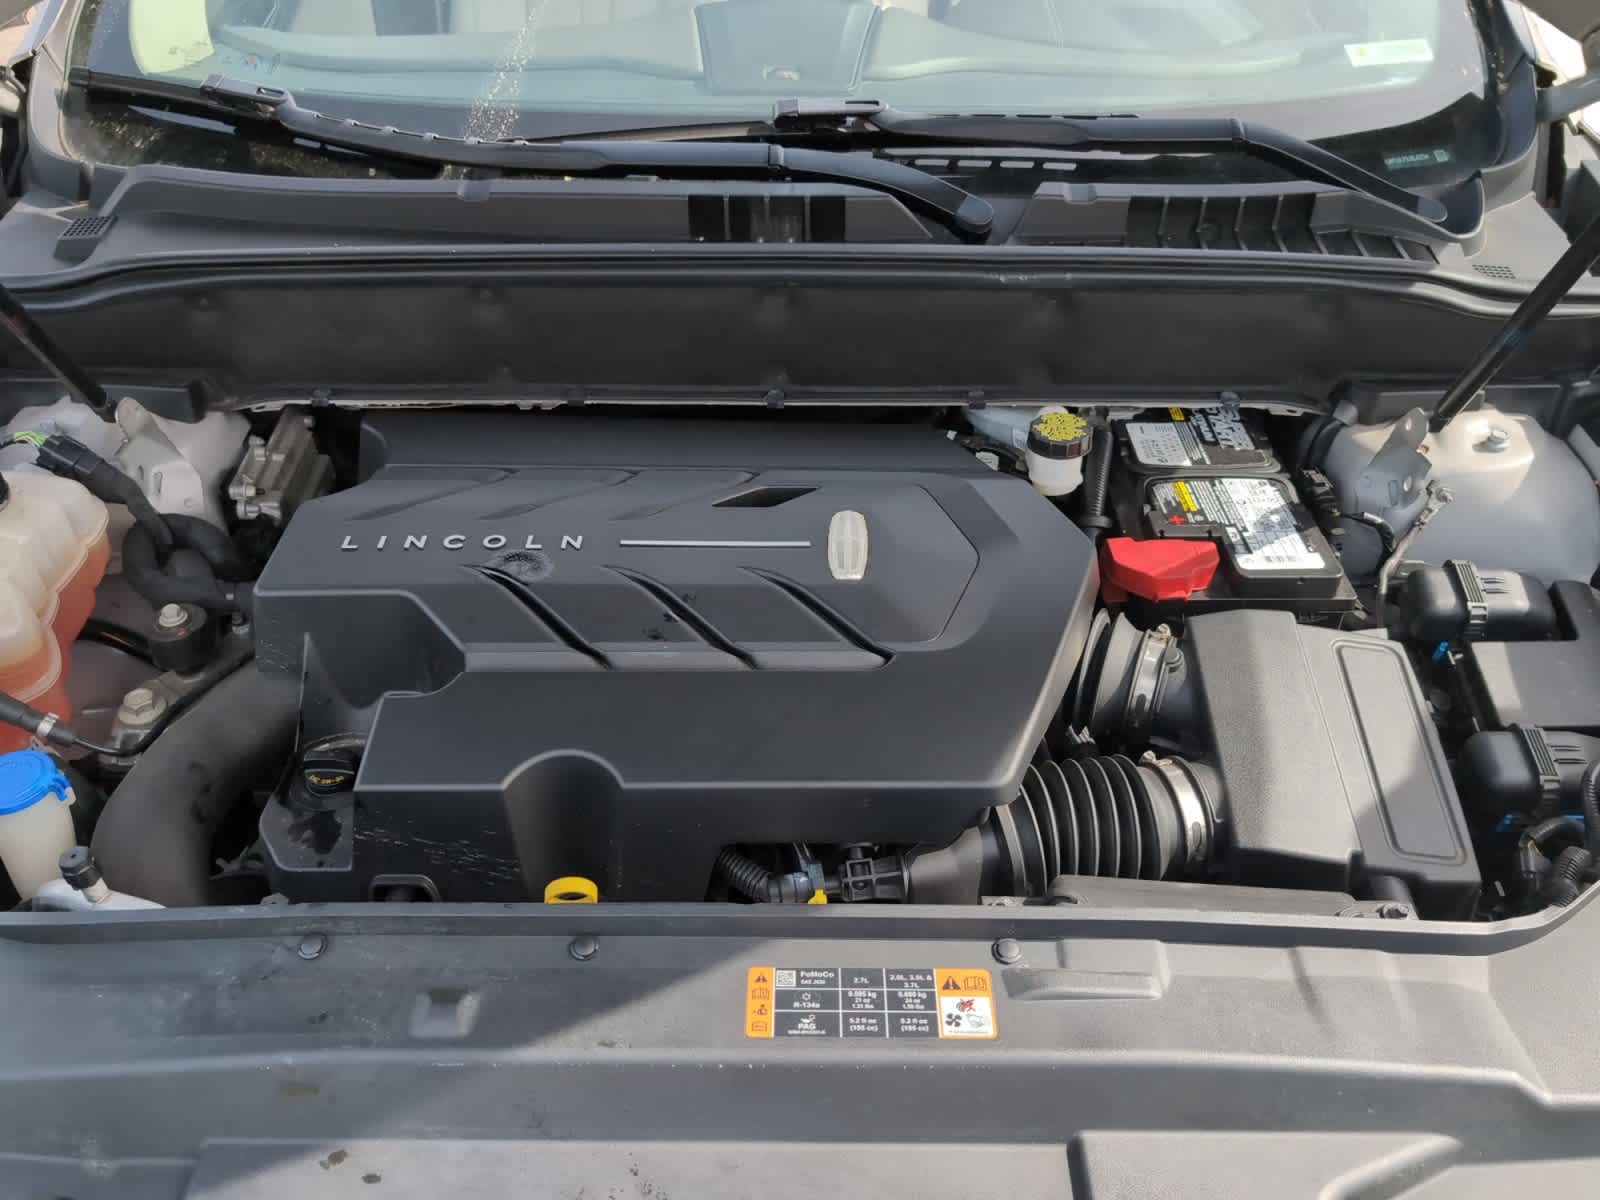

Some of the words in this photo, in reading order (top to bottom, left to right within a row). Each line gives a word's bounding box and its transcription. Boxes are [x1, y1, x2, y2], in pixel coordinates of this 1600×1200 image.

[340, 534, 583, 549] LINCOLN
[800, 970, 835, 978] FoMoCo
[853, 976, 870, 984] 2.7L
[867, 990, 877, 999] kg
[917, 991, 927, 999] kg
[793, 1001, 821, 1009] R-134a
